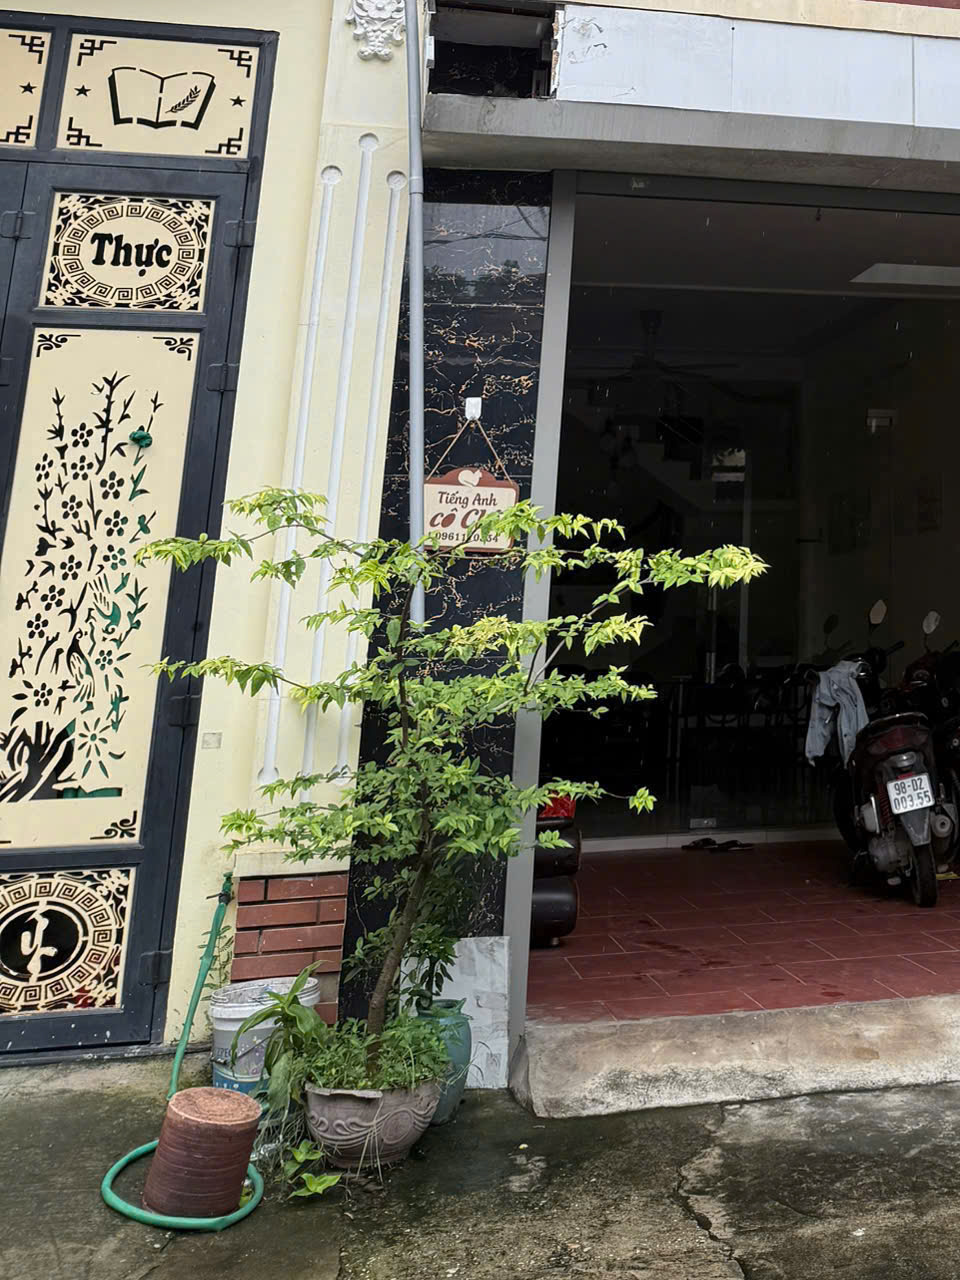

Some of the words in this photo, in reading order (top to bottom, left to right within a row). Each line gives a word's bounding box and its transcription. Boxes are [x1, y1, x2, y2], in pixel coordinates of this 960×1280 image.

[91, 233, 172, 277] Thực
[438, 491, 469, 508] Tiếng
[472, 493, 497, 506] Anh
[894, 778, 924, 796] 98-D2
[893, 790, 931, 811] 003.55
